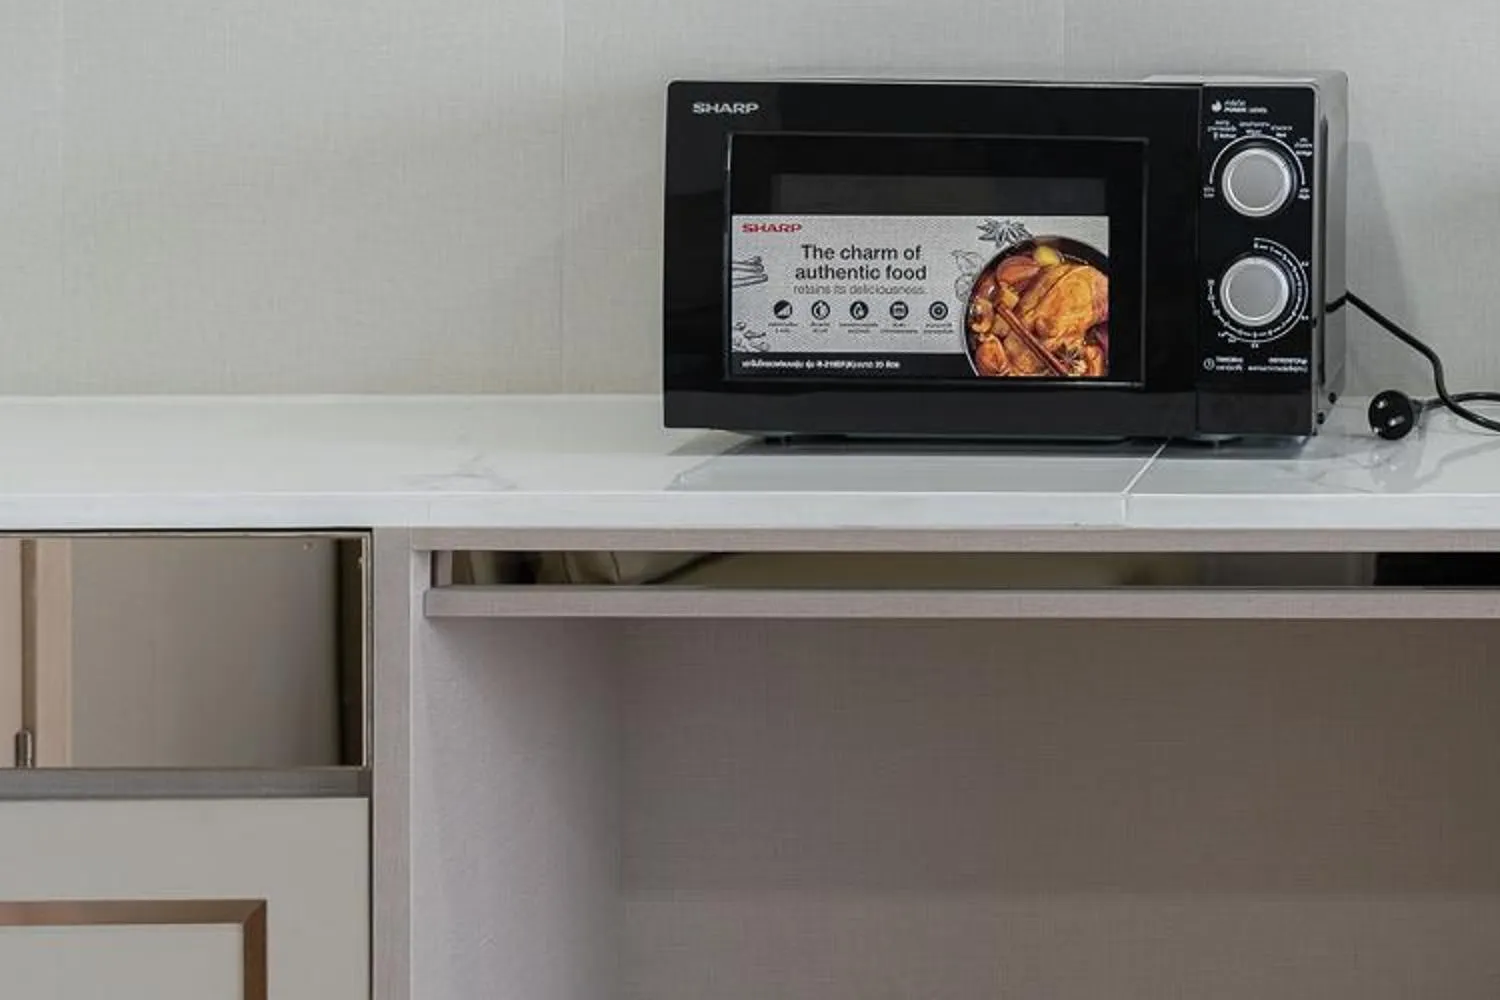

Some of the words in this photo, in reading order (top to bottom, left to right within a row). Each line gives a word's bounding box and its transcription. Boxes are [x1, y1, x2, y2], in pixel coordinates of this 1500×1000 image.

[692, 101, 760, 115] SHARP
[742, 223, 802, 233] SHARP
[801, 244, 835, 260] The
[839, 244, 898, 260] charm
[903, 244, 922, 260] of
[795, 264, 881, 280] authentic
[885, 264, 927, 280] food
[793, 284, 830, 295] retains
[833, 284, 847, 295] its
[849, 284, 928, 295] deliciousness.
